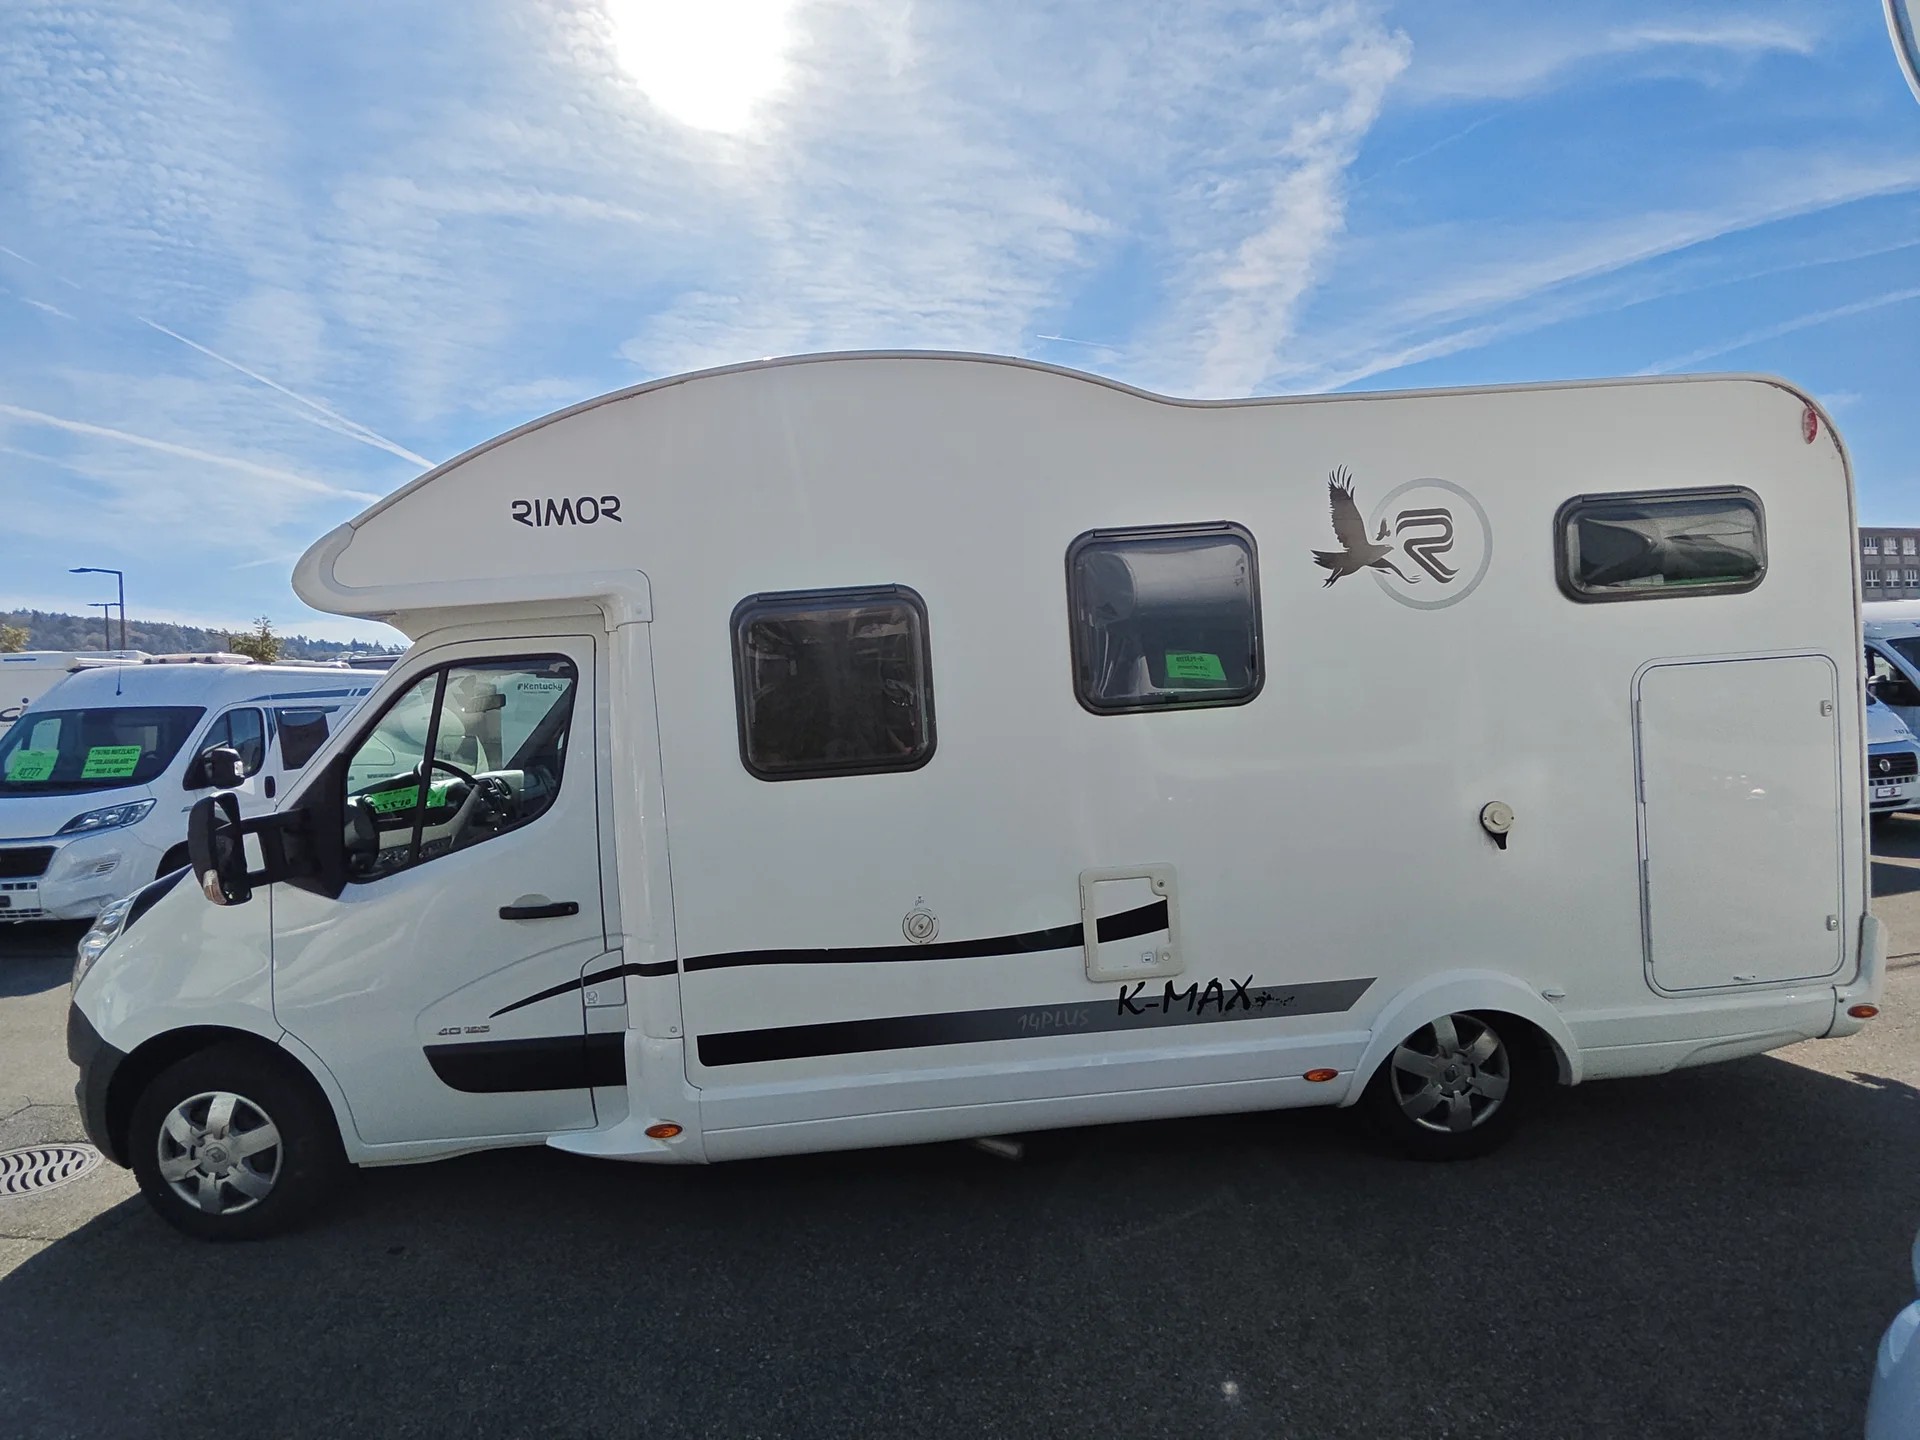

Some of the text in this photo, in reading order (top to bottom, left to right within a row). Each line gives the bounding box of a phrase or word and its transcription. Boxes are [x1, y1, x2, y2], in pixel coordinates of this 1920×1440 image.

[511, 495, 623, 527] RIMOR
[1117, 974, 1255, 1017] K-MAX
[1017, 1007, 1090, 1033] 14PLUS
